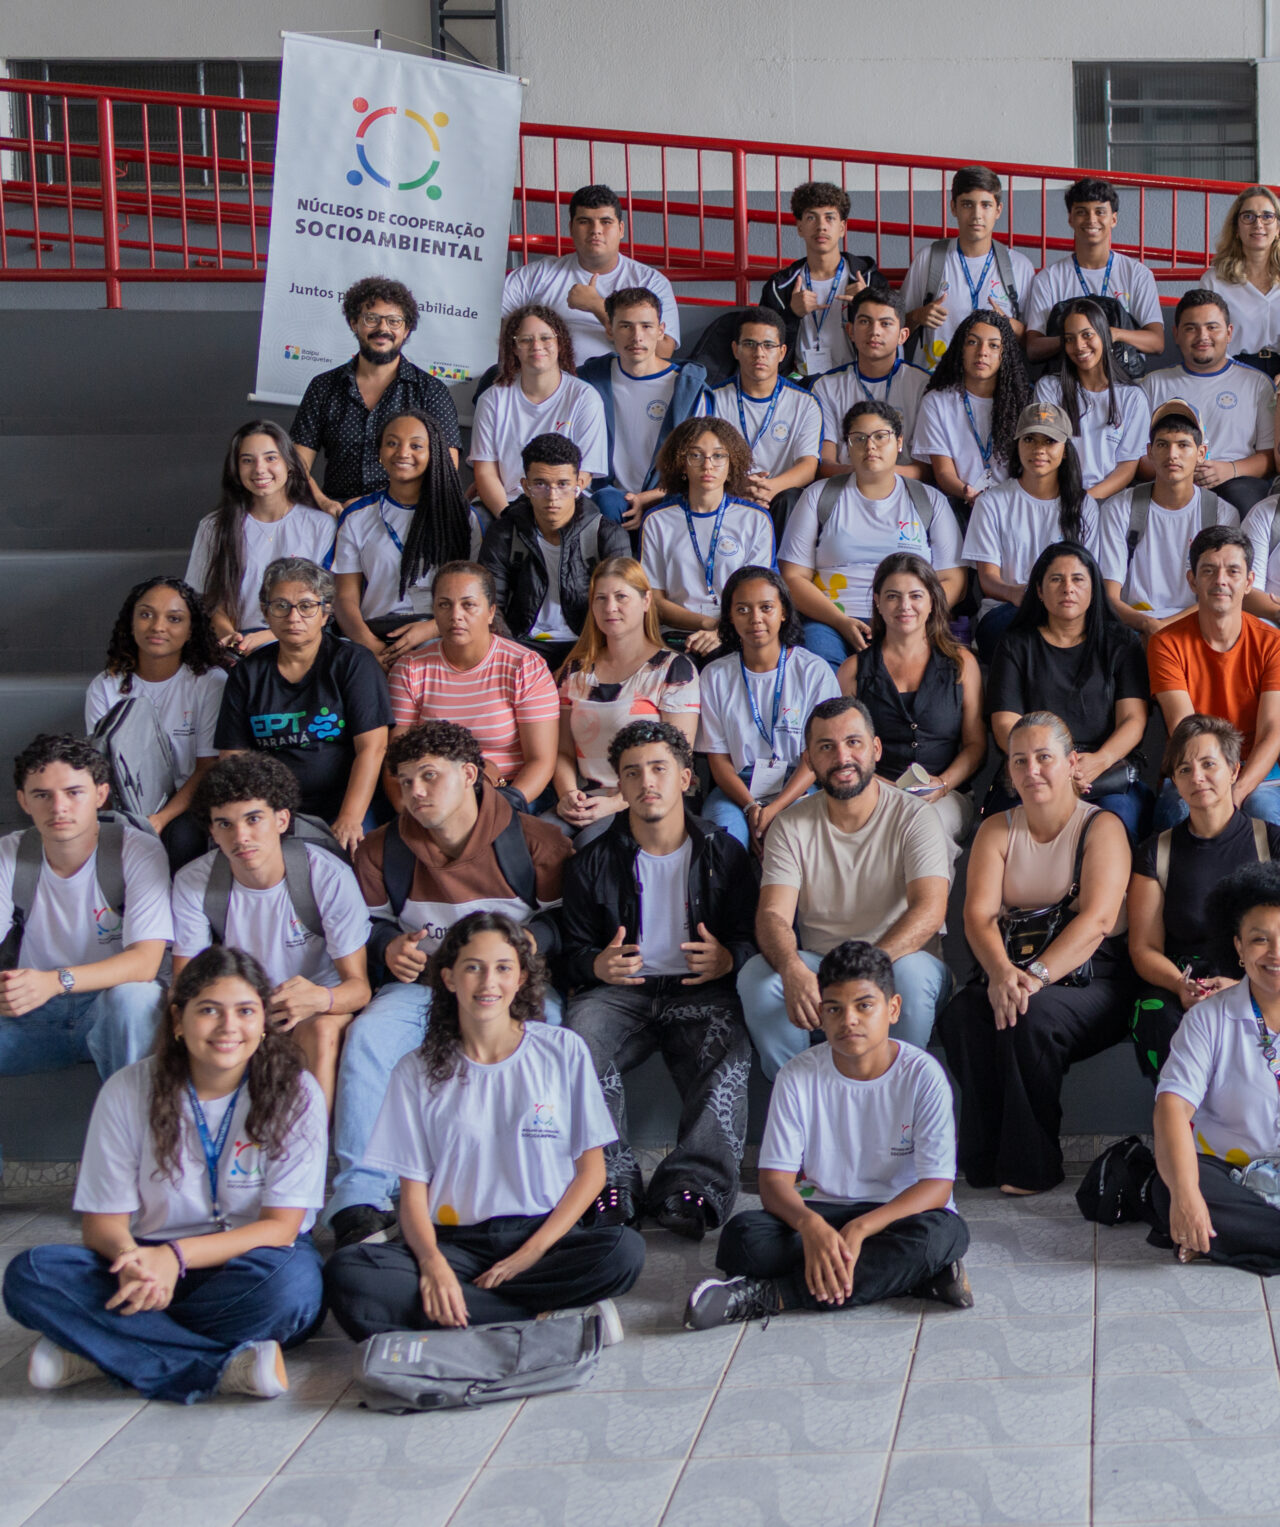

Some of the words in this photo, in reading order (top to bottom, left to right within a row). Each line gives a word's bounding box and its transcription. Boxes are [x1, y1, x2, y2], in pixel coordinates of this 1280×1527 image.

[297, 197, 364, 219] NÚCLEOS
[367, 209, 386, 223] DE
[388, 213, 485, 239] COOPERAÇÃO
[295, 218, 483, 262] SOCIOAMBIENTAL
[289, 282, 334, 299] Juntos
[417, 300, 479, 319] abilidade
[250, 711, 307, 738] EPT
